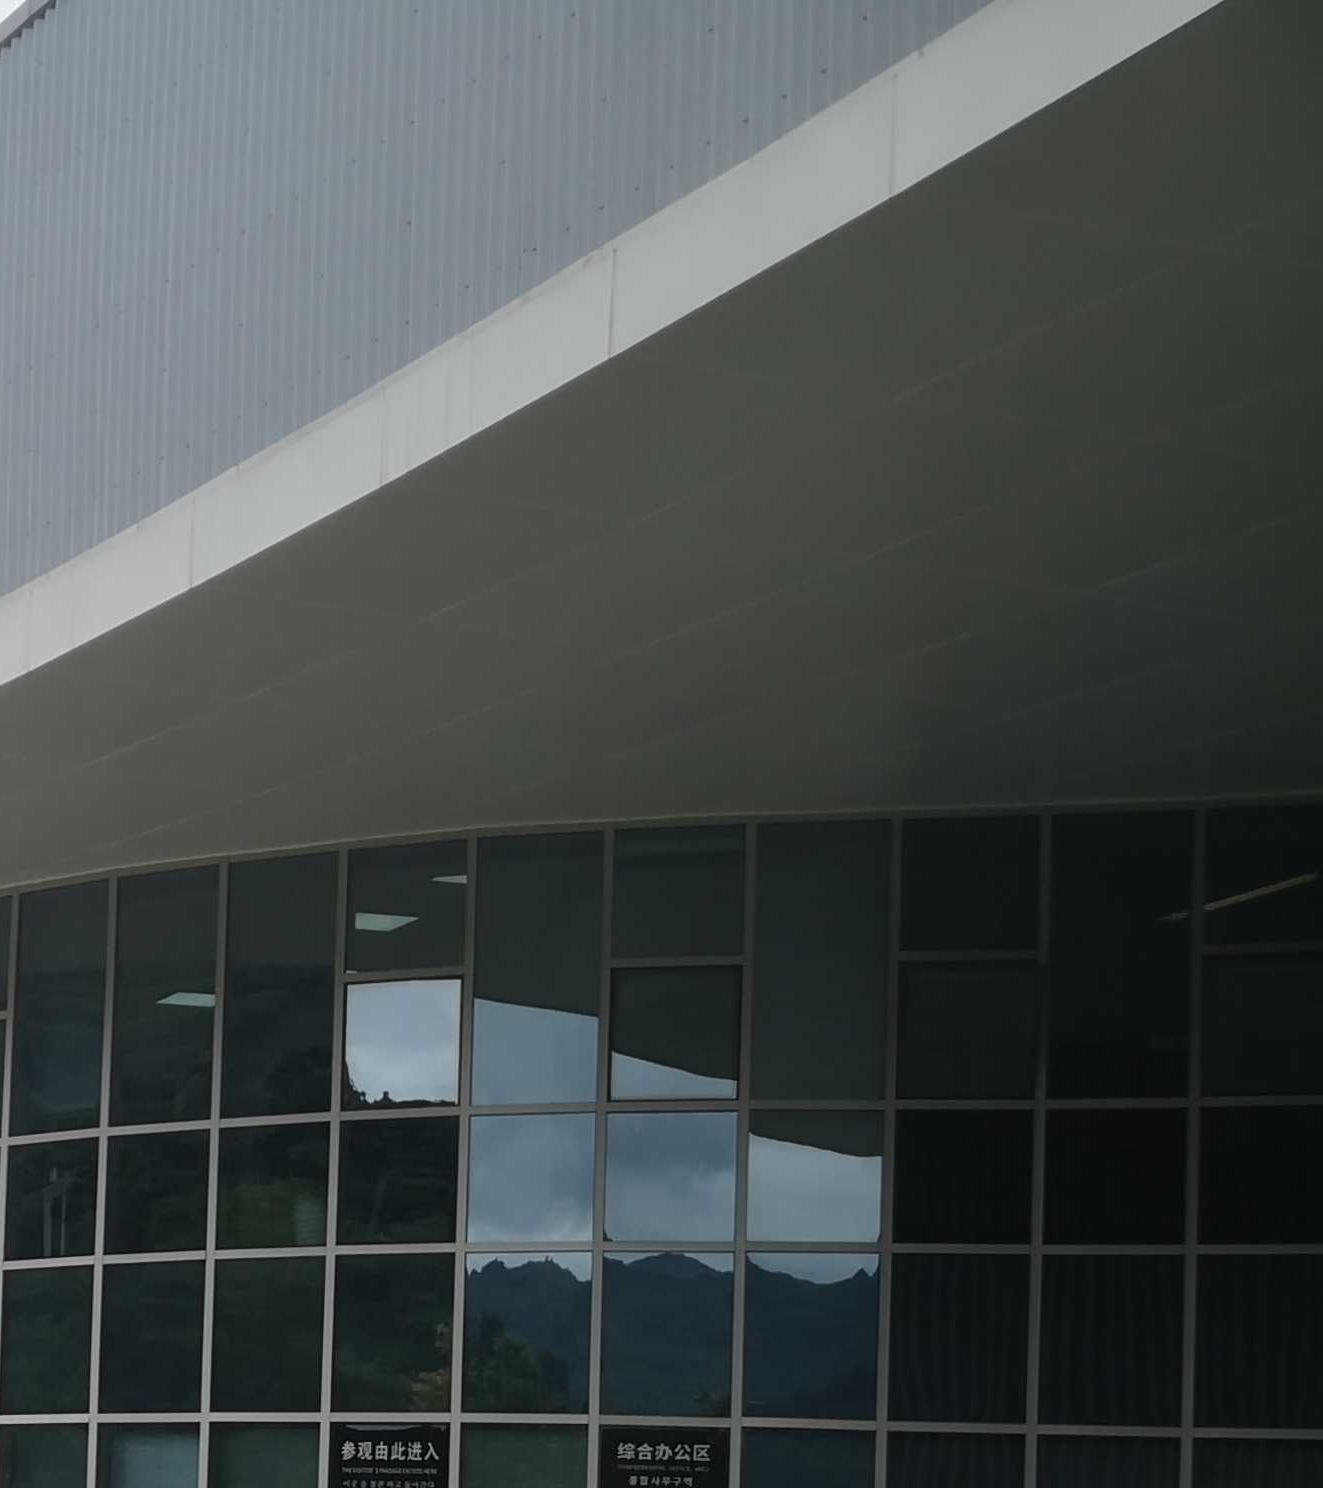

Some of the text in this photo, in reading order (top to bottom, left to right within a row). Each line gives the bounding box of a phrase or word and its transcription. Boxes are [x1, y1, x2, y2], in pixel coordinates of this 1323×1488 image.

[341, 1440, 440, 1461] 参观由此进入
[617, 1442, 711, 1461] 综合办公区
